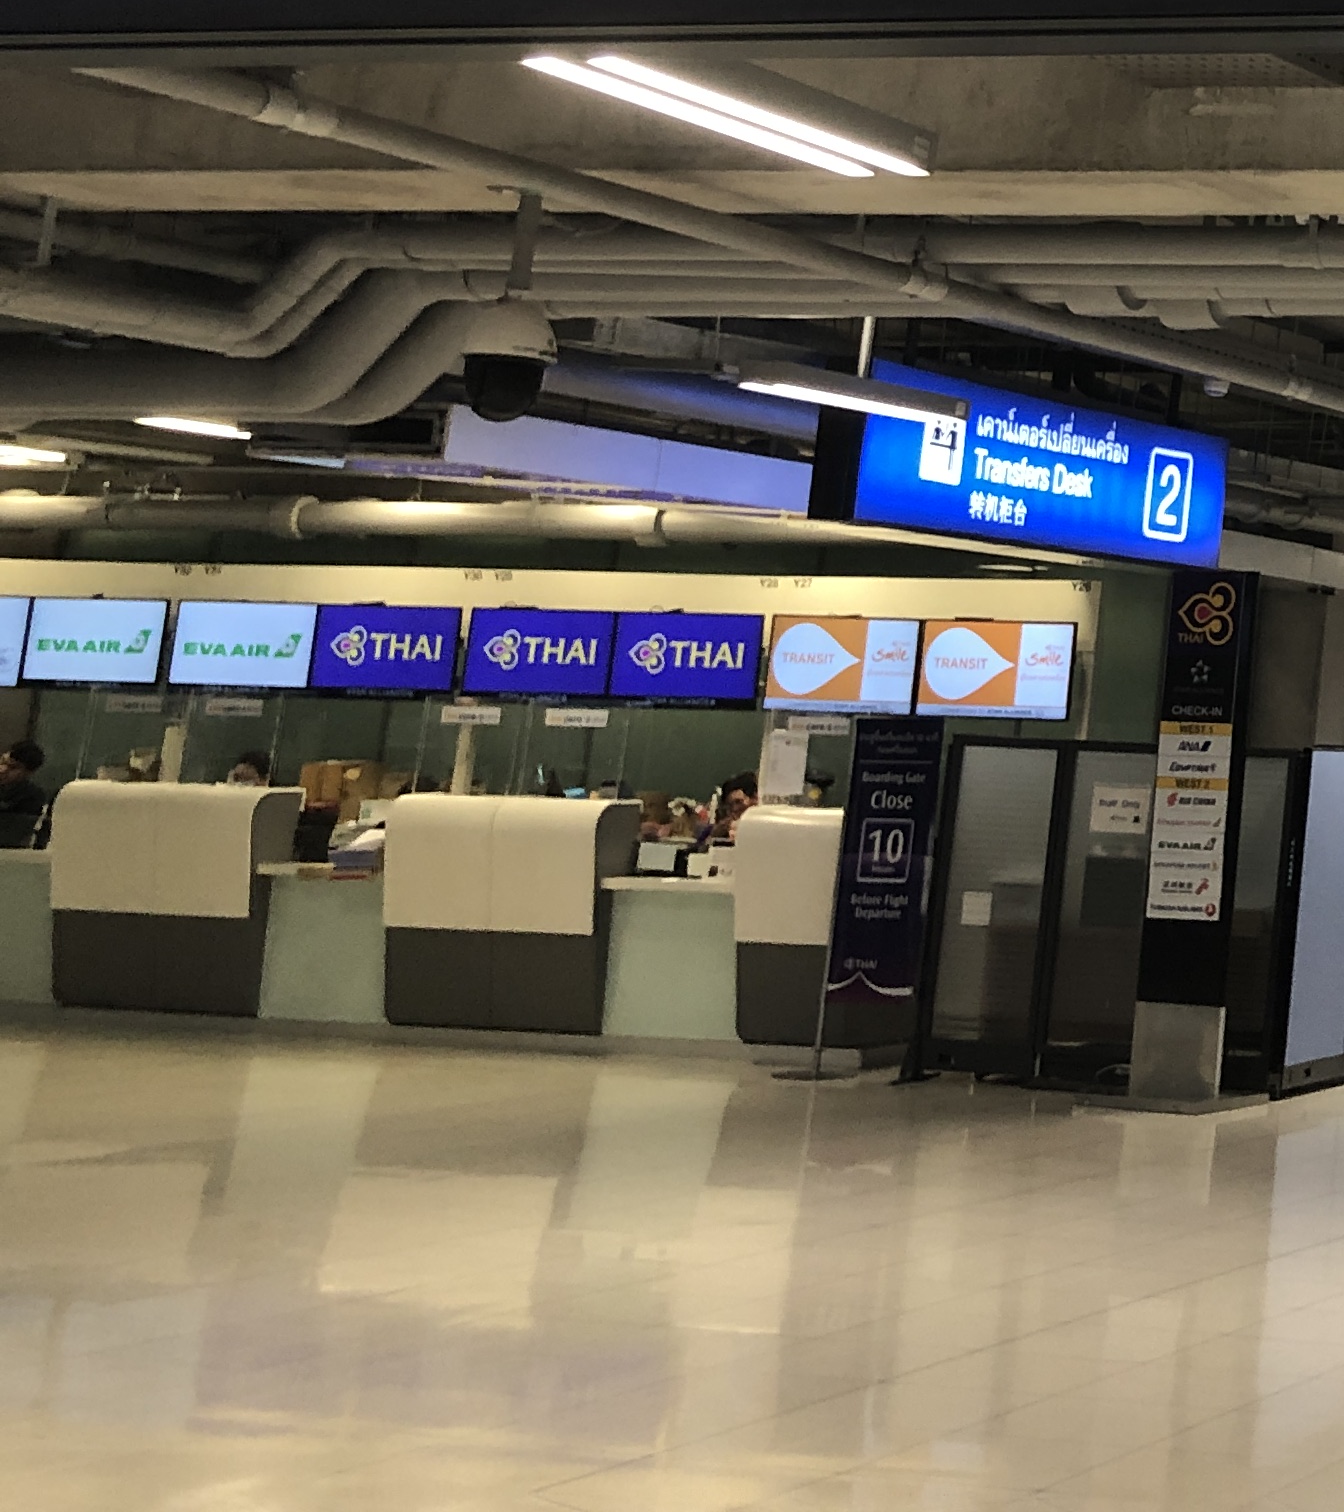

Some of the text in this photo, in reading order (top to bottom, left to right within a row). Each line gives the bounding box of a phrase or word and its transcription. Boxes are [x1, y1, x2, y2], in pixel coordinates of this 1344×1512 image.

[977, 408, 1129, 464] เคาน์เตอร์เปลี่ยนเครื่อง
[974, 447, 1094, 499] Transfers Desk
[1155, 464, 1182, 526] 2
[37, 638, 122, 653] EVA AIR
[1178, 632, 1205, 644] THAI
[183, 641, 271, 658] EVA AIR
[370, 632, 443, 662] THAI
[523, 635, 598, 666] THAI
[667, 639, 746, 670] THAI
[782, 651, 836, 665] TRANSIT
[934, 656, 989, 671] TRANSIT
[1171, 704, 1223, 717] CHECK-IN
[861, 770, 927, 786] Boarding Gate
[870, 789, 914, 810] Close
[867, 828, 905, 864] 10
[850, 892, 883, 906] Before
[854, 906, 902, 921] Departure
